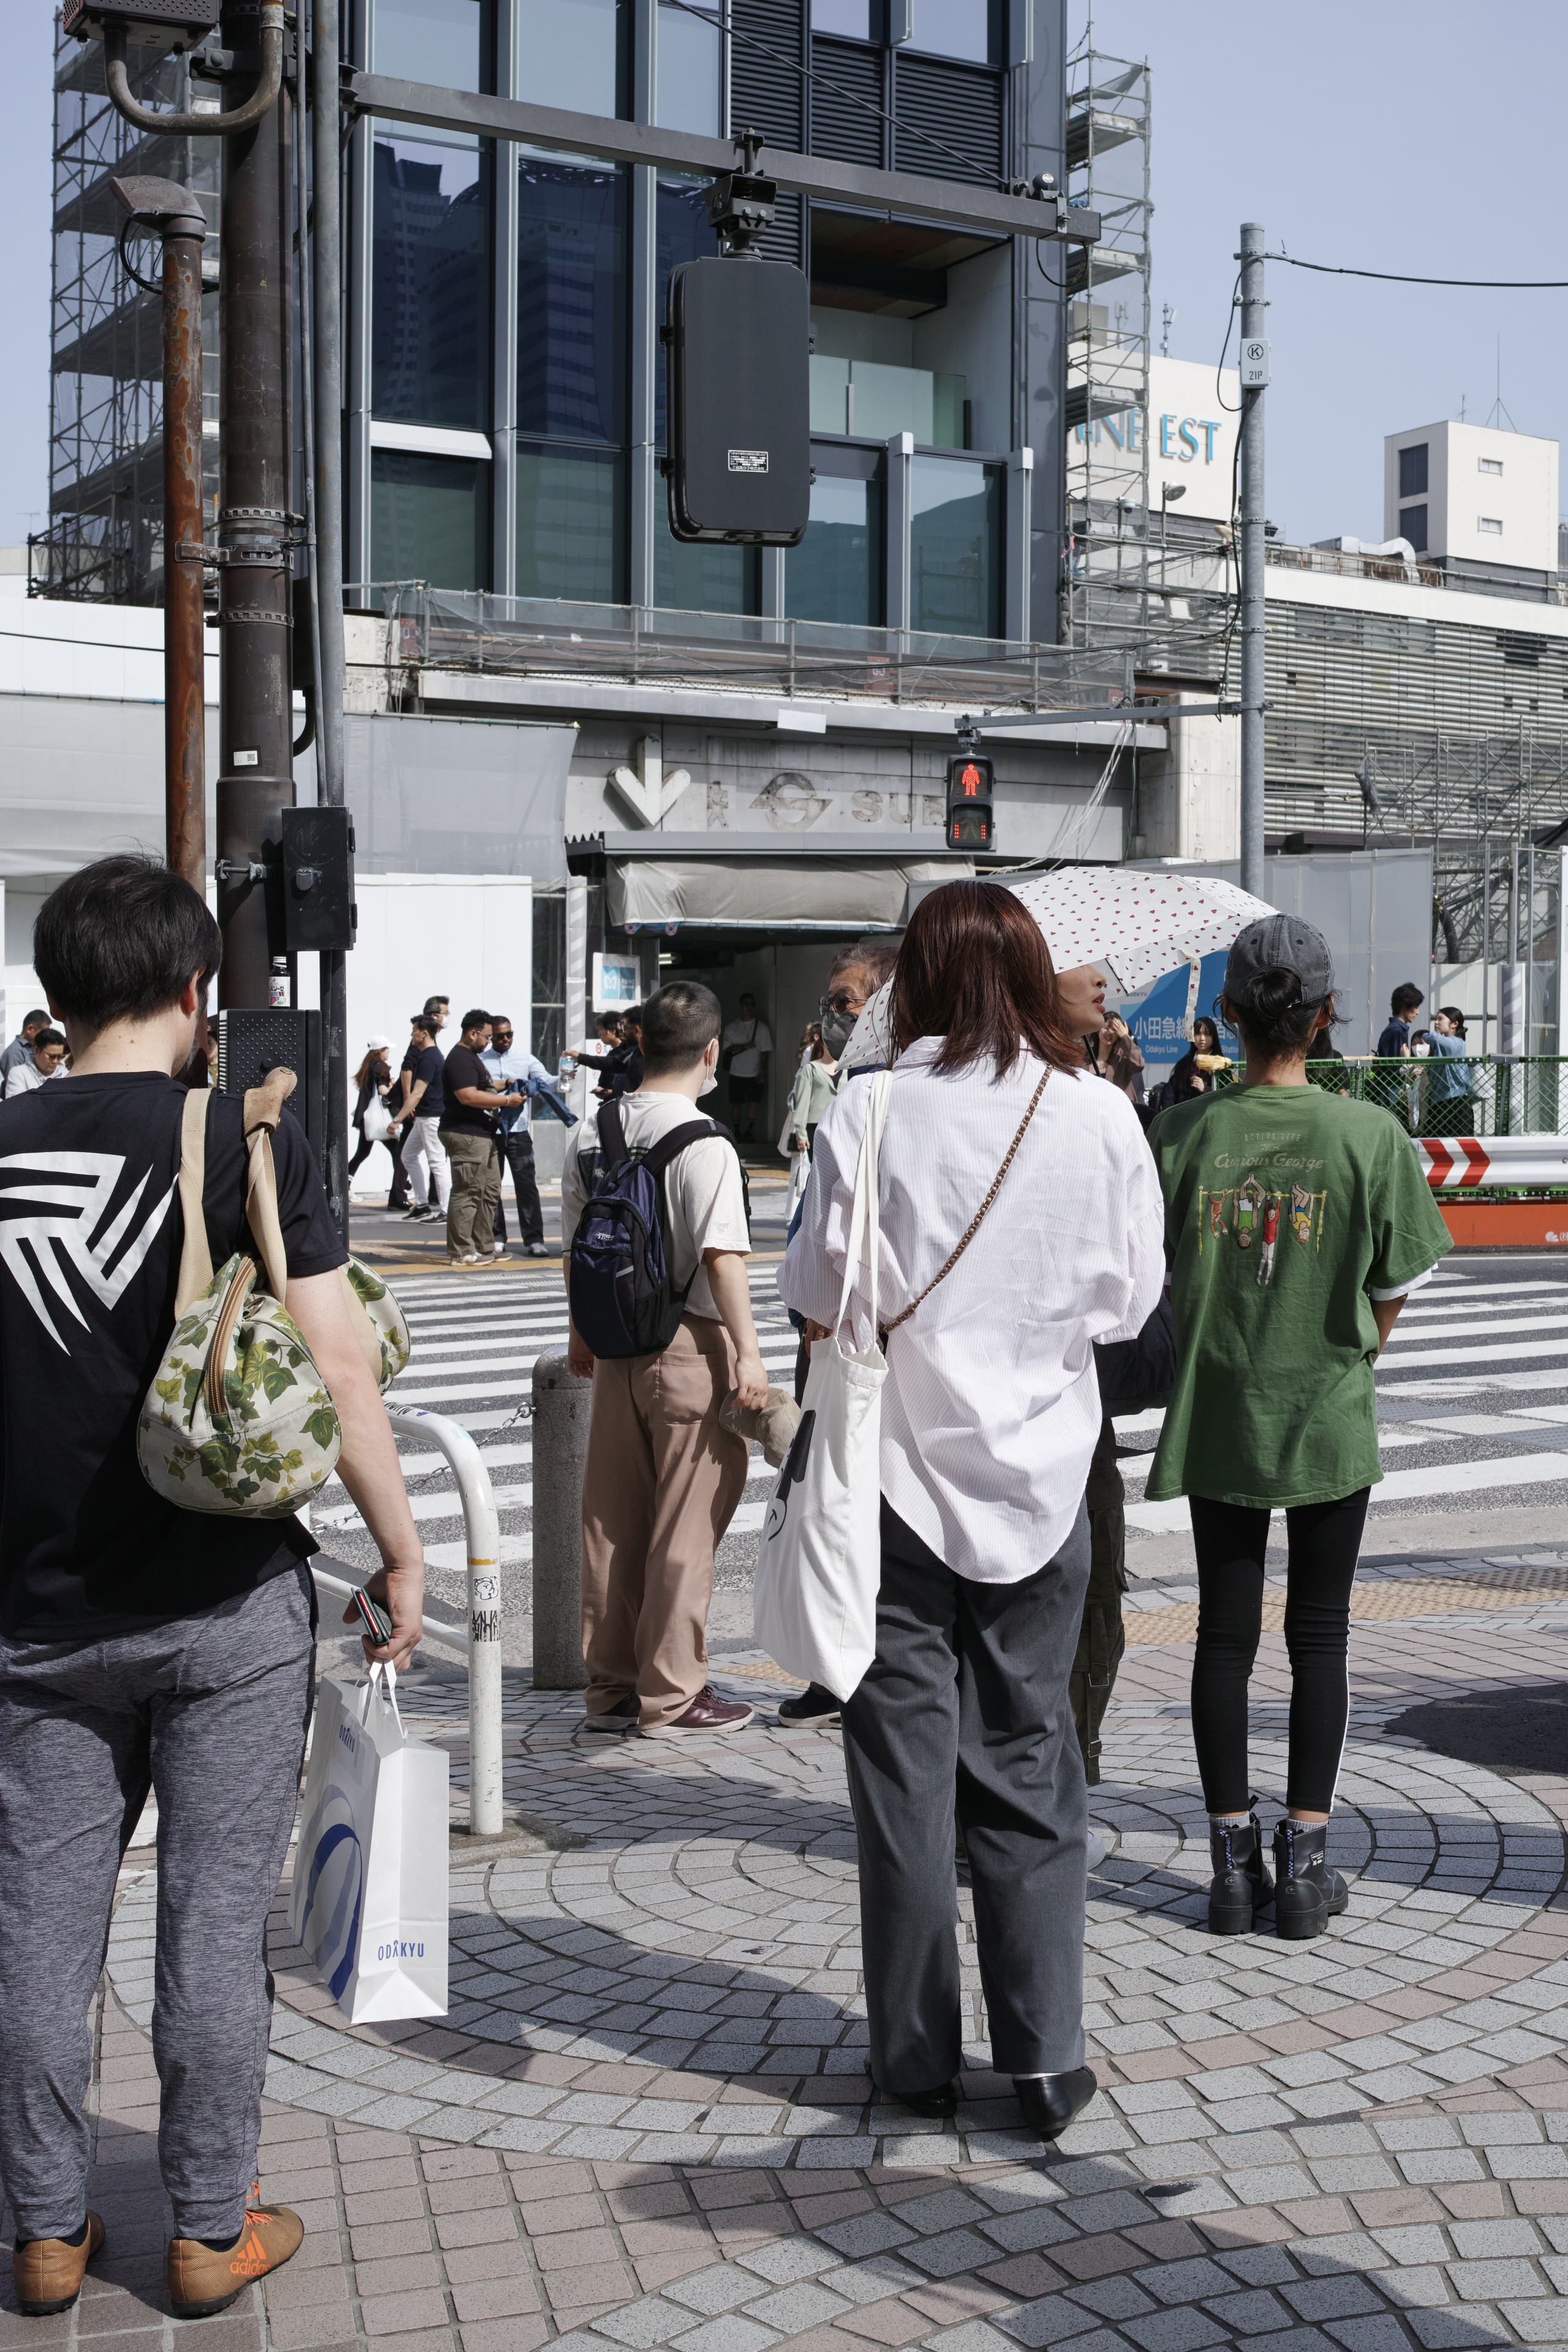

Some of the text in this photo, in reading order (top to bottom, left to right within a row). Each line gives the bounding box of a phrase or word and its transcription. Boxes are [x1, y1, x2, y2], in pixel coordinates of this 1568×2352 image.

[1162, 413, 1222, 461] EST
[1145, 1044, 1238, 1055] Odakyu Line Statio
[1244, 1133, 1301, 1142] ACTIVE LIFE
[1214, 1153, 1324, 1173] Curious George
[339, 1724, 355, 1753] ODAKYU
[378, 1940, 424, 1961] ODAKYU
[230, 2258, 271, 2275] adidas
